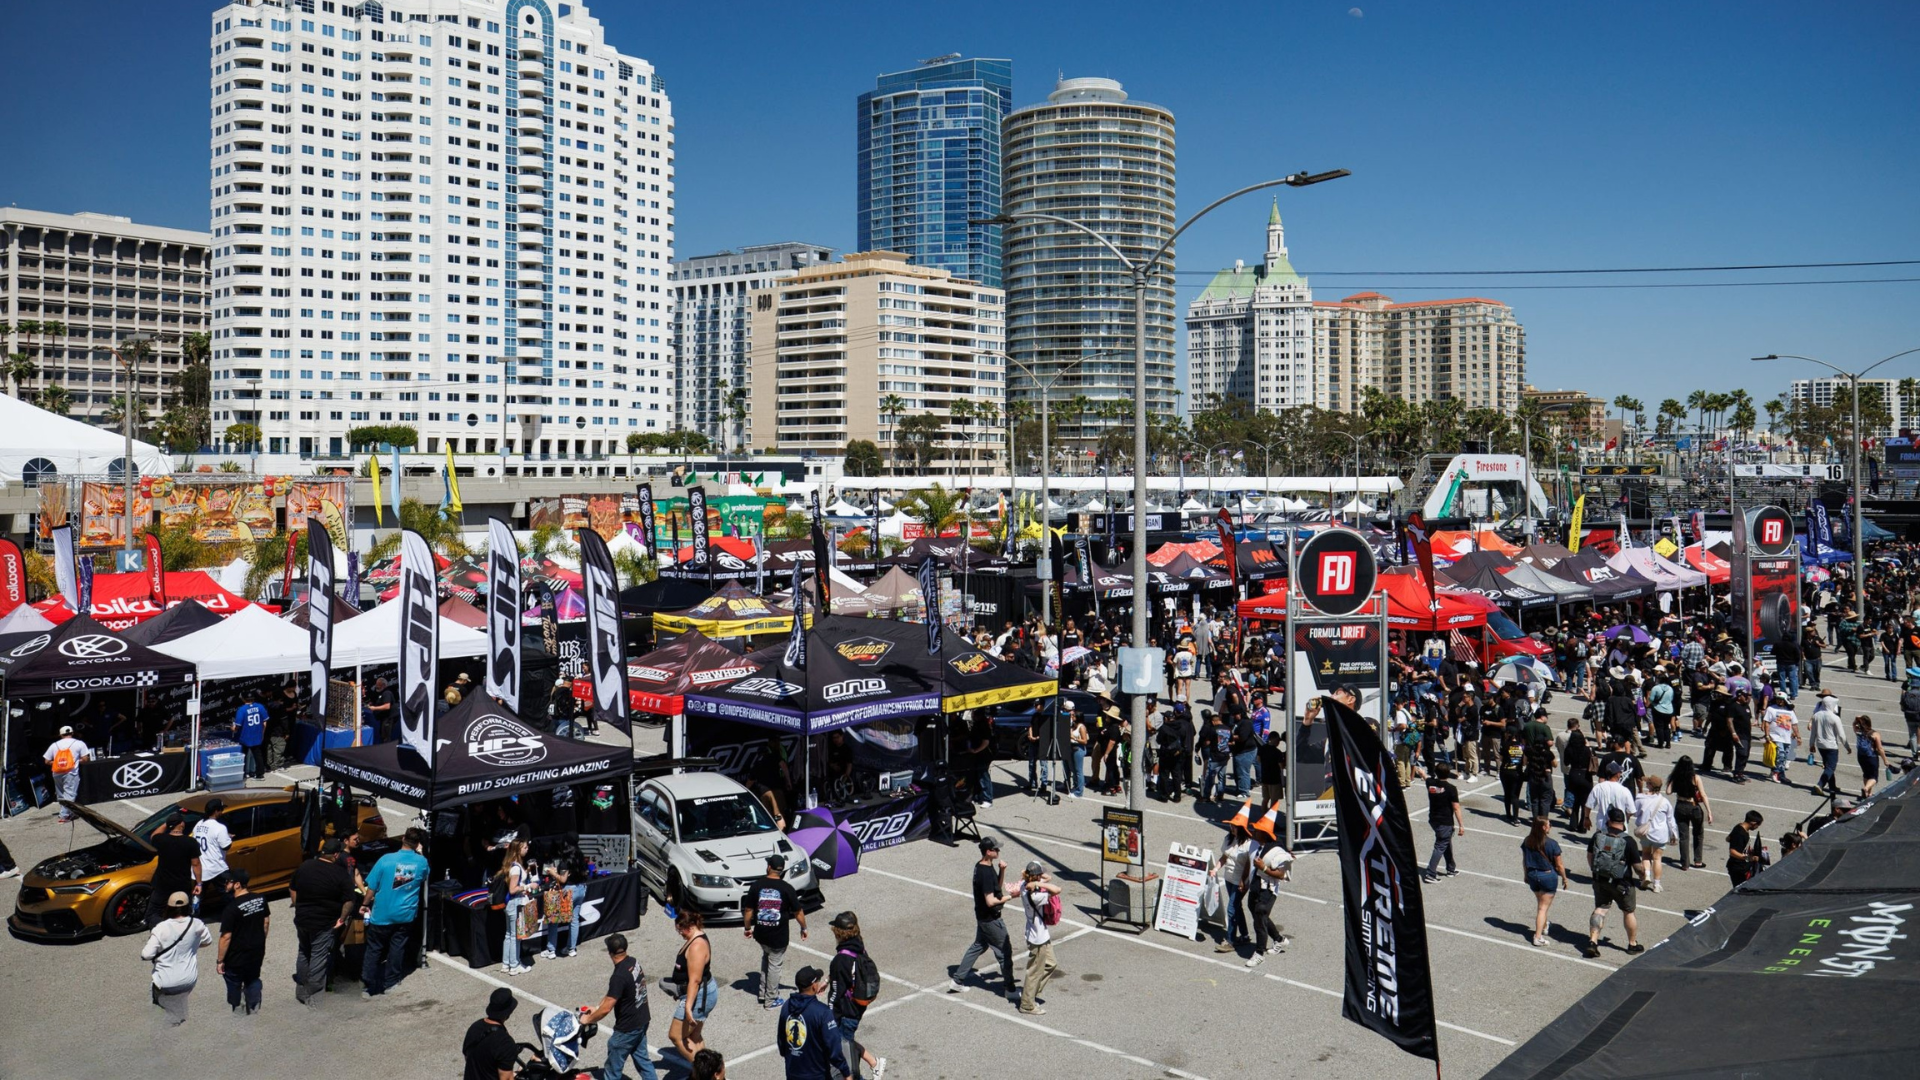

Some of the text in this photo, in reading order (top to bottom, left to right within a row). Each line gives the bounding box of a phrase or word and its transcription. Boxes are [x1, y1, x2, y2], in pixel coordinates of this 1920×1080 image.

[758, 294, 772, 308] 600
[1476, 461, 1507, 473] Firestone
[1827, 465, 1841, 479] 16
[731, 503, 764, 512] wahlburgers
[1765, 522, 1781, 544] FD
[124, 553, 138, 570] K
[1078, 548, 1089, 584] GReddy
[4, 553, 19, 601] wilwood
[150, 548, 161, 593] wilwood
[1322, 555, 1351, 591] FD
[1162, 583, 1190, 592] GReddy
[1209, 579, 1233, 588] GRedd
[1111, 588, 1134, 598] GRed
[1309, 626, 1366, 639] FORMULA DRIFT
[68, 656, 132, 665] KOYORAD
[1136, 654, 1151, 687] J
[55, 675, 135, 690] KOYORAD
[726, 689, 759, 697] PERFORMANCE
[828, 692, 867, 703] PERFORMANCE
[247, 714, 260, 726] 50
[718, 705, 801, 727] @DNDPERFORMANCEINTERIOR
[810, 697, 939, 730] WWW.DNDPERFORMANCEINTERIOR.COM
[470, 718, 528, 741] PERFORMANCE
[468, 735, 544, 757] HPS
[324, 760, 426, 798] SERVING THE INDUSTRY SINCE 2007
[458, 759, 610, 795] BUILD SOMETHING AMAZING
[113, 788, 159, 799] KOYORAD
[196, 825, 209, 834] BETTS
[878, 835, 906, 848] INTERIOR
[1752, 919, 1832, 974] ENERG
[1361, 908, 1377, 1013] SIM RACING
